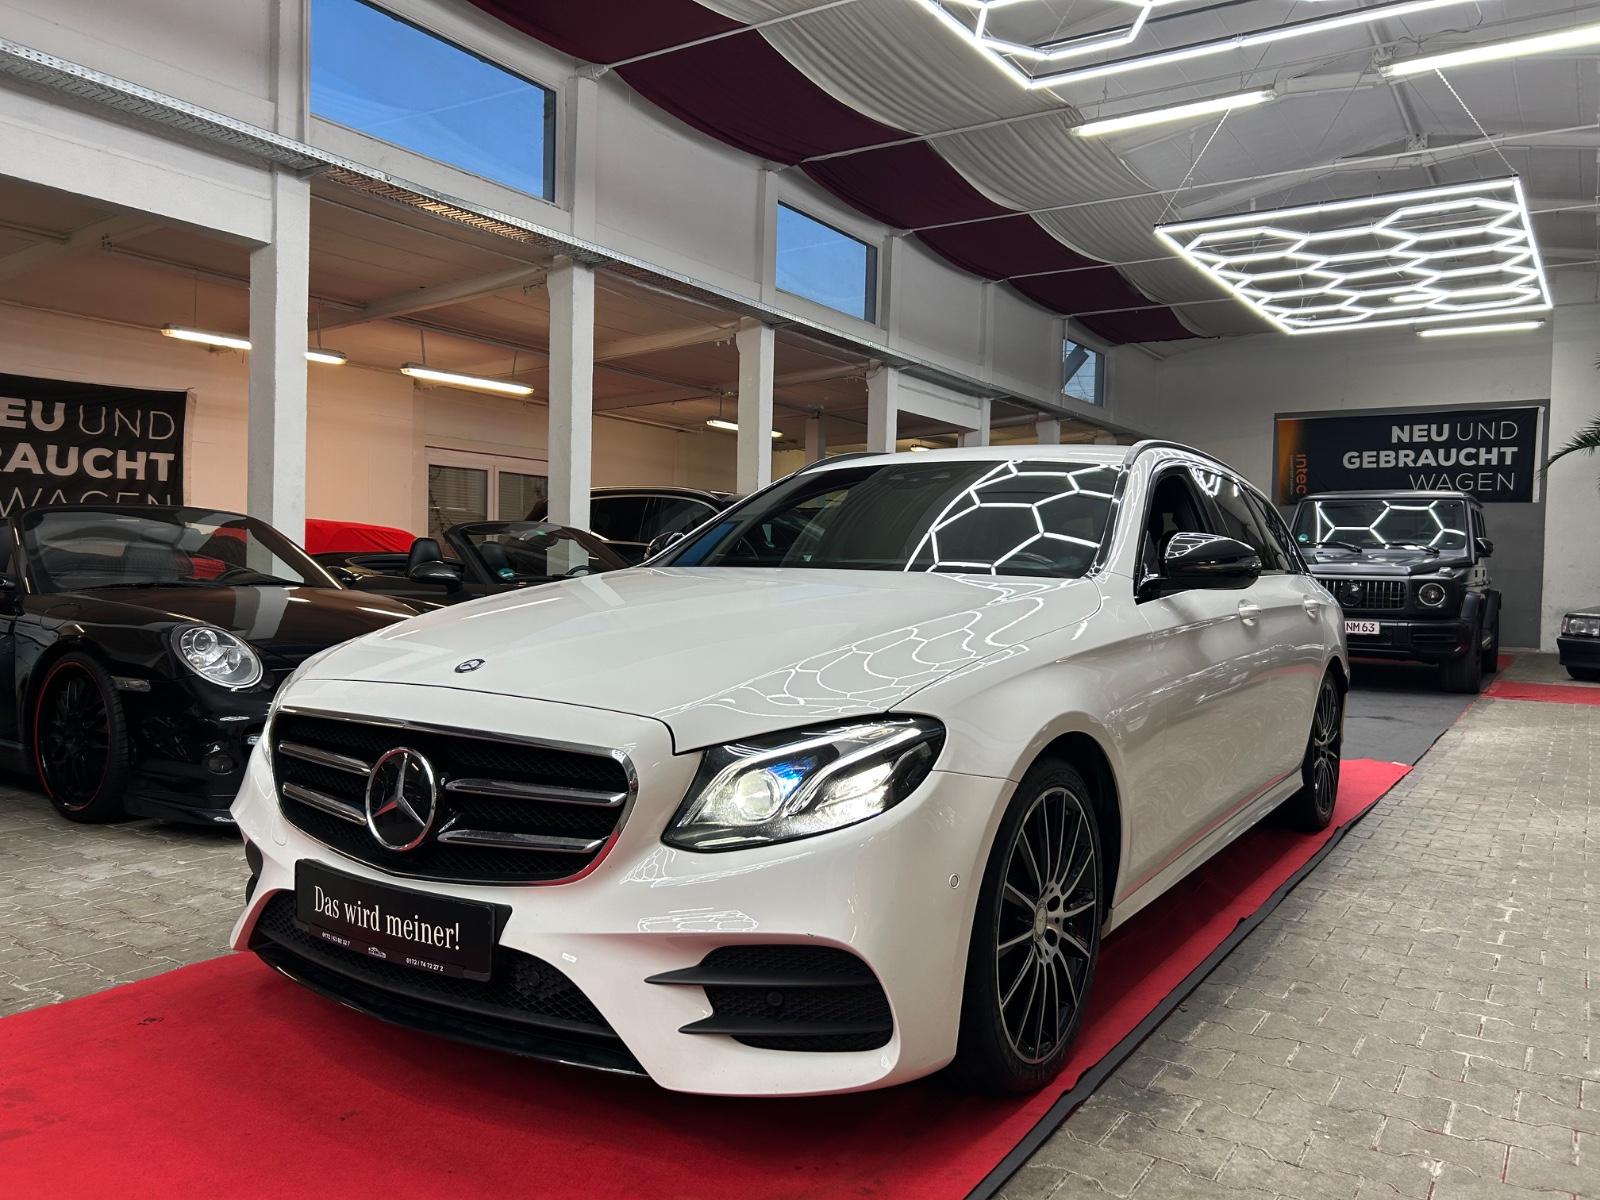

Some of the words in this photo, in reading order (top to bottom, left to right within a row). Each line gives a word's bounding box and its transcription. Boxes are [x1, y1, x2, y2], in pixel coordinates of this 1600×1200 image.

[79, 404, 175, 440] UND
[1391, 423, 1449, 444] NEU
[1456, 421, 1518, 441] UND
[0, 442, 175, 482] AUCHT
[1342, 446, 1518, 470] GEBRAUCHT
[1295, 453, 1308, 494] intec
[1409, 471, 1515, 491] WAGEN
[1346, 621, 1360, 632] NM
[1362, 622, 1375, 633] 63
[314, 885, 340, 919] Das
[344, 900, 380, 932] wird
[386, 914, 460, 951] meiner!
